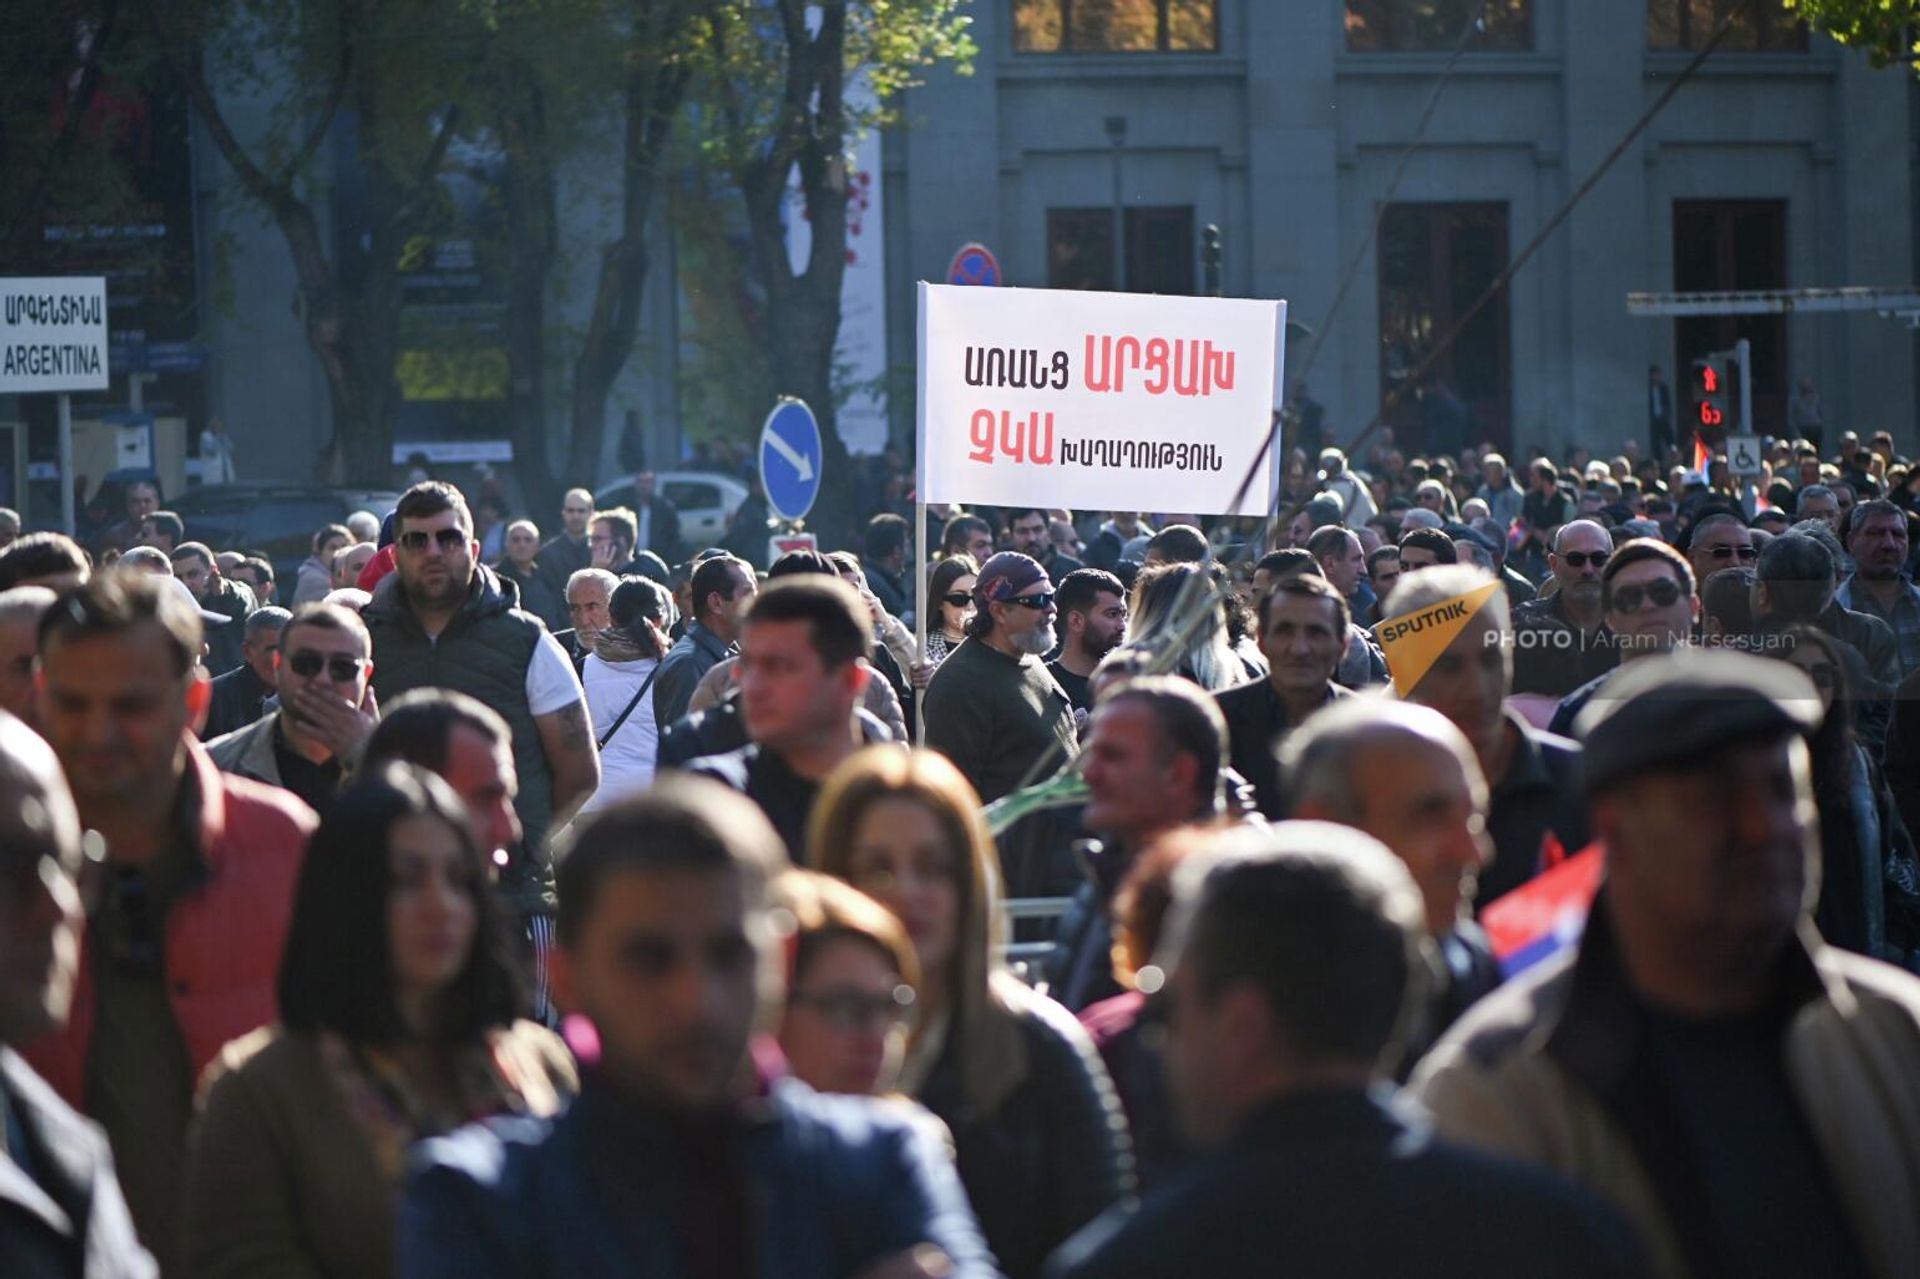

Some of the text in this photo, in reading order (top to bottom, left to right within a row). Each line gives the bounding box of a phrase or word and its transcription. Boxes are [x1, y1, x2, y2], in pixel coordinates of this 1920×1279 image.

[5, 294, 102, 326] ԱՐԳԵՆՏԻՆԱ
[4, 344, 101, 376] ARGENTINA
[965, 335, 1235, 396] ԱՌԱՆՑ ԱՐՑԱԽ
[968, 408, 1055, 465] ՉԿԱ
